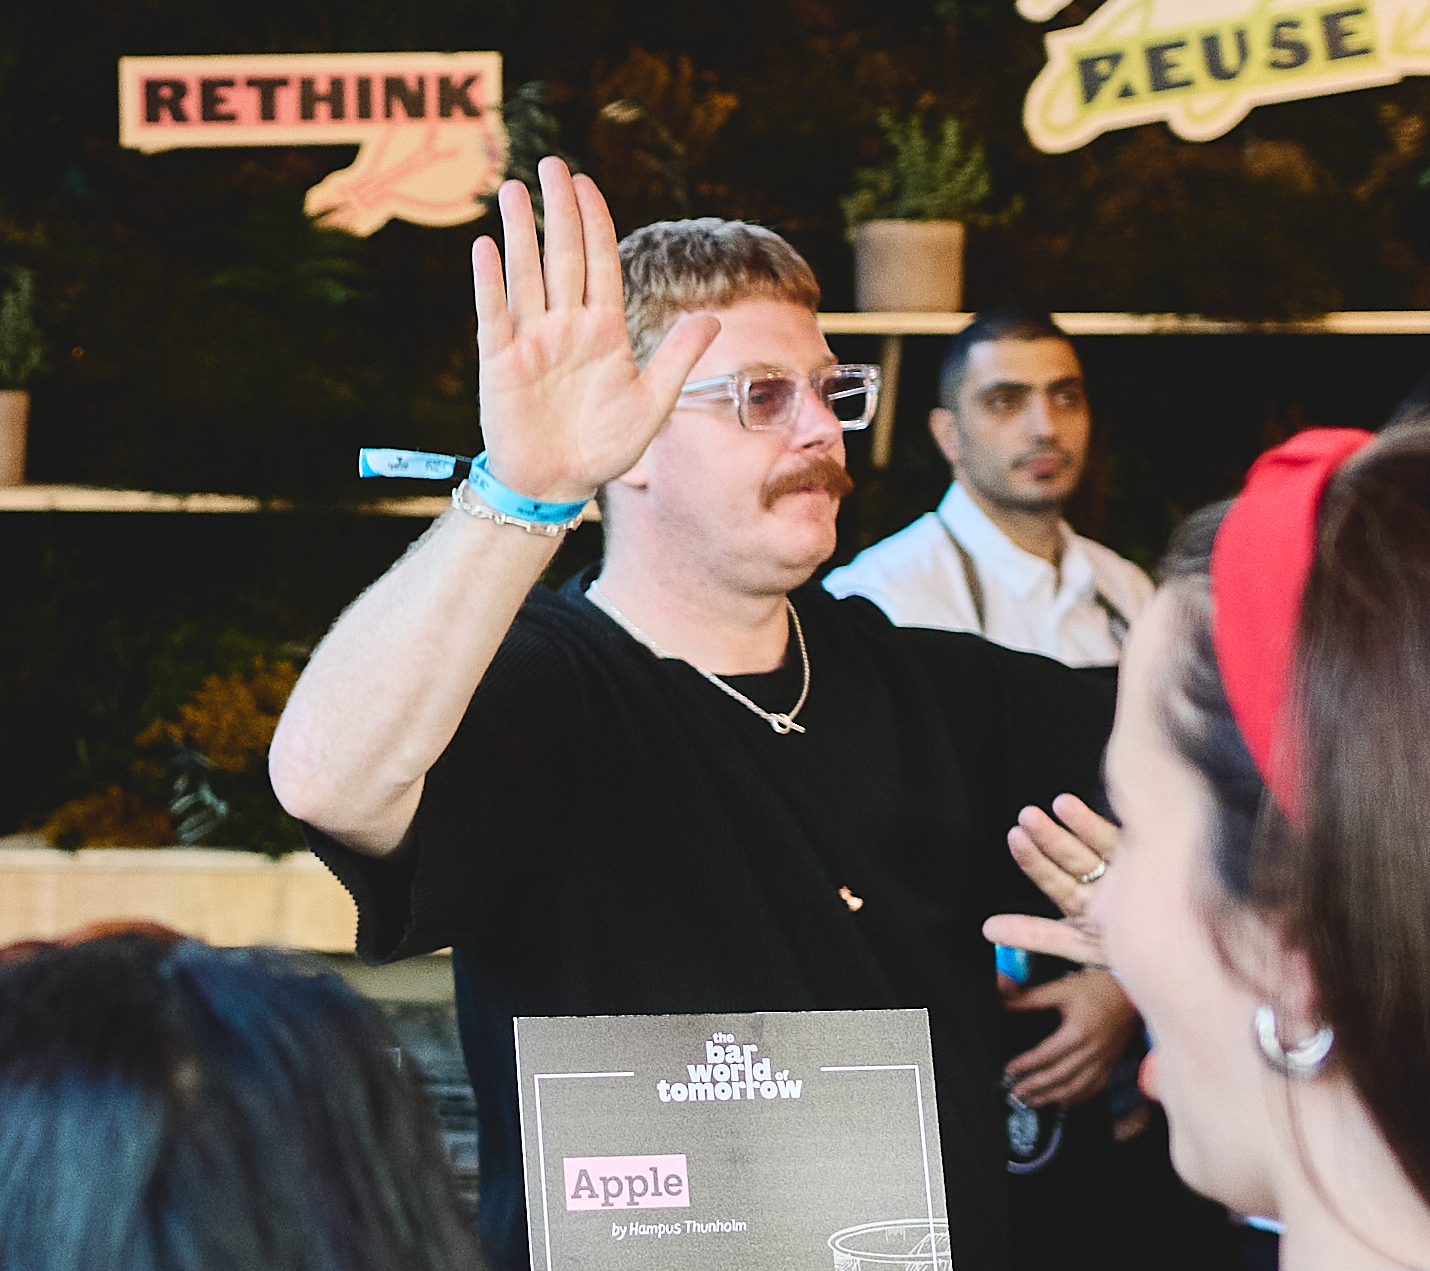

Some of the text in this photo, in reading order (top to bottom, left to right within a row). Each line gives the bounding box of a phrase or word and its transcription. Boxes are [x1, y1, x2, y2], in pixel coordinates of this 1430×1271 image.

[1077, 6, 1374, 105] REUSE
[144, 73, 483, 124] RETHINK
[712, 1032, 735, 1044] the
[705, 1040, 759, 1064] bar
[686, 1057, 790, 1083] world of
[656, 1079, 803, 1103] tomorrow
[570, 1166, 683, 1207] Apple
[611, 1219, 748, 1241] by Hampus Thunholm
